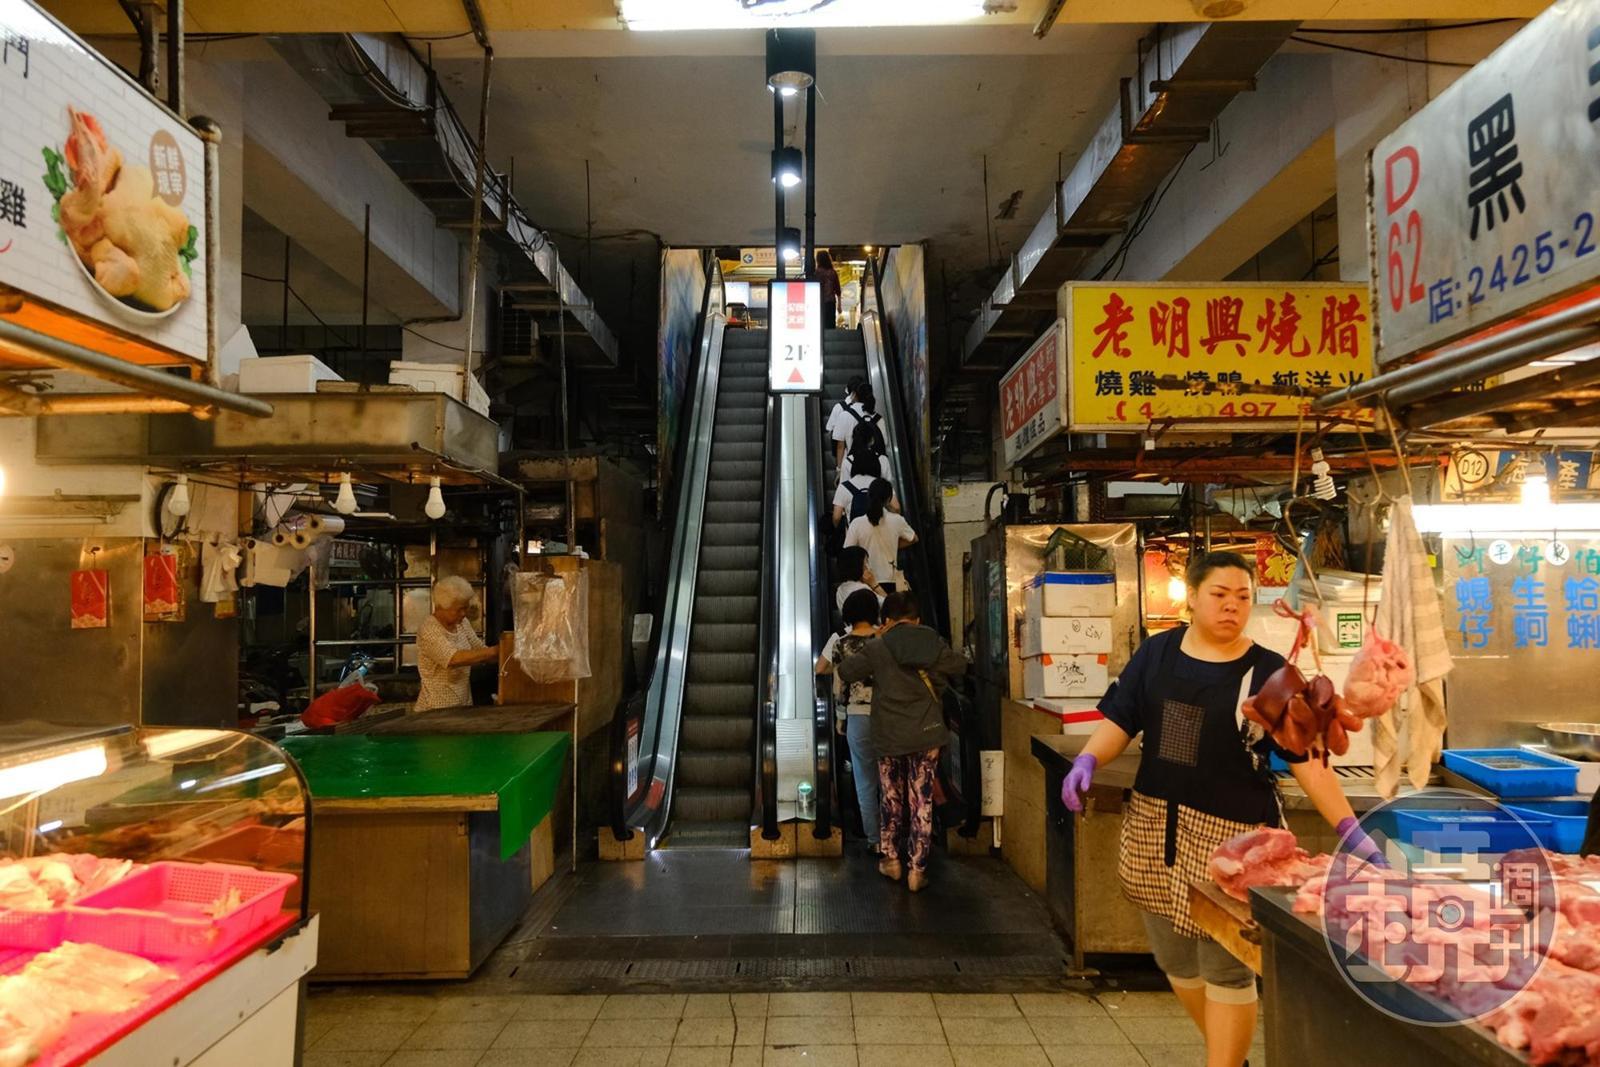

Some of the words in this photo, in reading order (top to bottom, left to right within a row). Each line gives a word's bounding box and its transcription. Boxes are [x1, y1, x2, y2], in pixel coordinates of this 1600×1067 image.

[1385, 145, 1420, 216] D
[1468, 92, 1526, 241] 黑
[0, 178, 27, 229] 雞
[1388, 210, 1425, 312] 62
[1461, 457, 1483, 475] D12
[1455, 576, 1494, 648] 蜆仔
[1512, 575, 1549, 648] 生蚵
